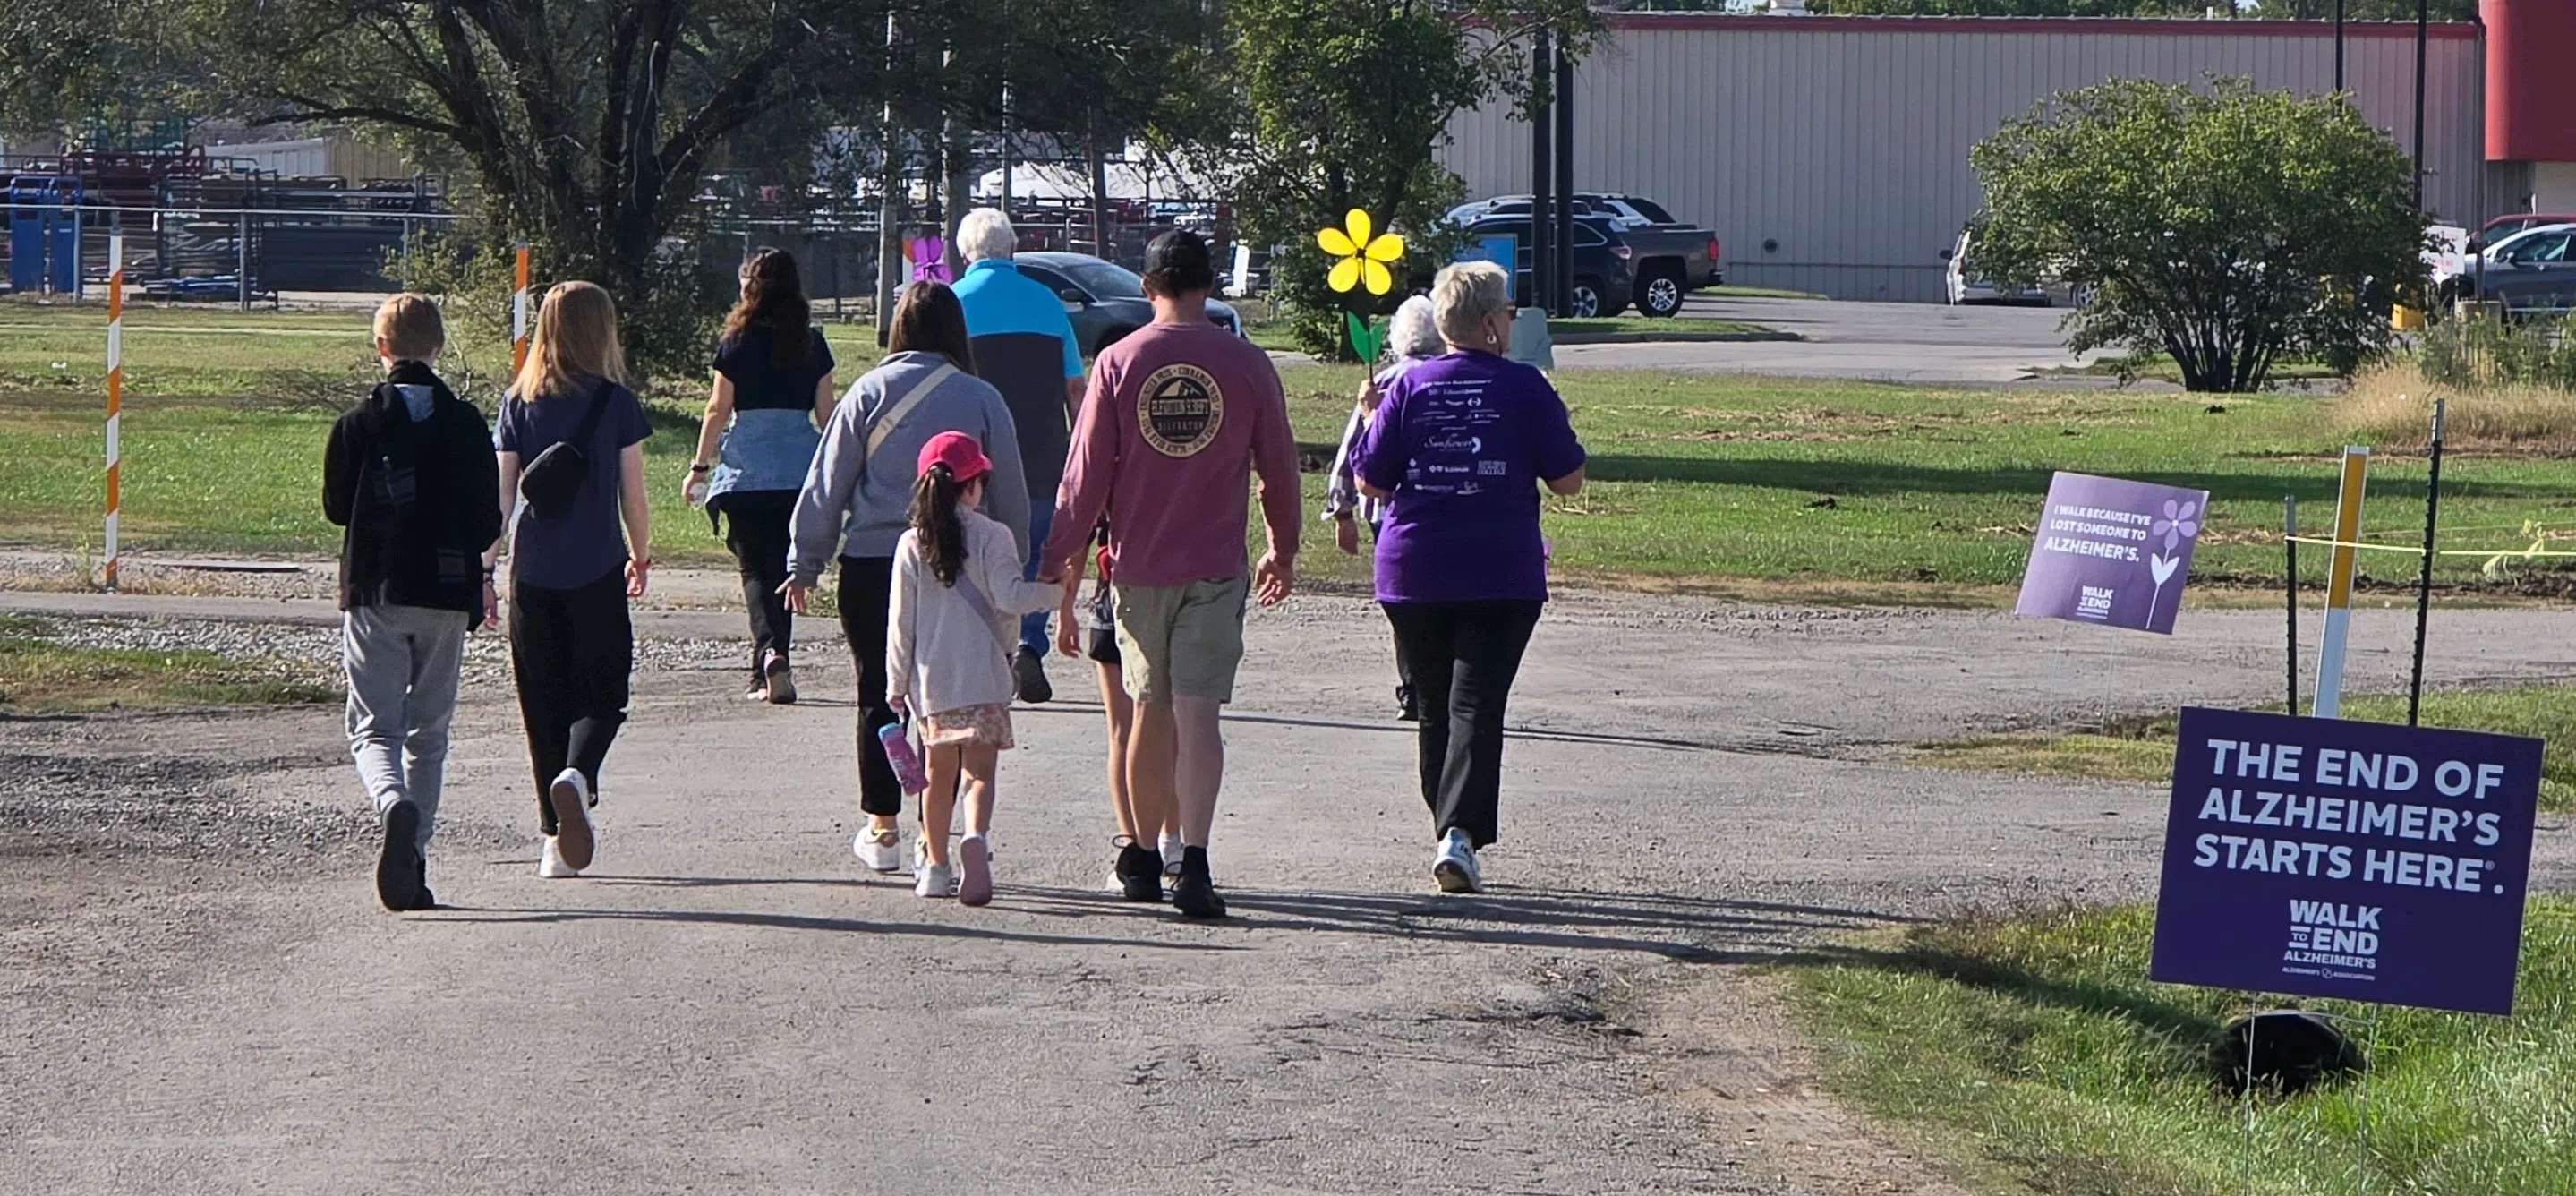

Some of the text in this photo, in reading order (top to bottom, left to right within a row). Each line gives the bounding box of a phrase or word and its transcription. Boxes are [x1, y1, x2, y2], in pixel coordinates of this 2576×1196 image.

[2054, 504, 2152, 526] I WALK BECAUSE I'VE
[2050, 518, 2147, 541] LOST SOMEONE TO
[2044, 536, 2140, 562] ALZHEIMER'S.
[2082, 585, 2113, 600] WALK
[2087, 597, 2111, 610] END
[2207, 739, 2505, 799] THE END OF
[2198, 787, 2502, 846] ALZHEIMER'S
[2193, 833, 2354, 880] STARTS
[2290, 899, 2383, 930] WALK
[2292, 927, 2379, 955] TO END
[2283, 950, 2376, 969] ALZHEIMER'S
